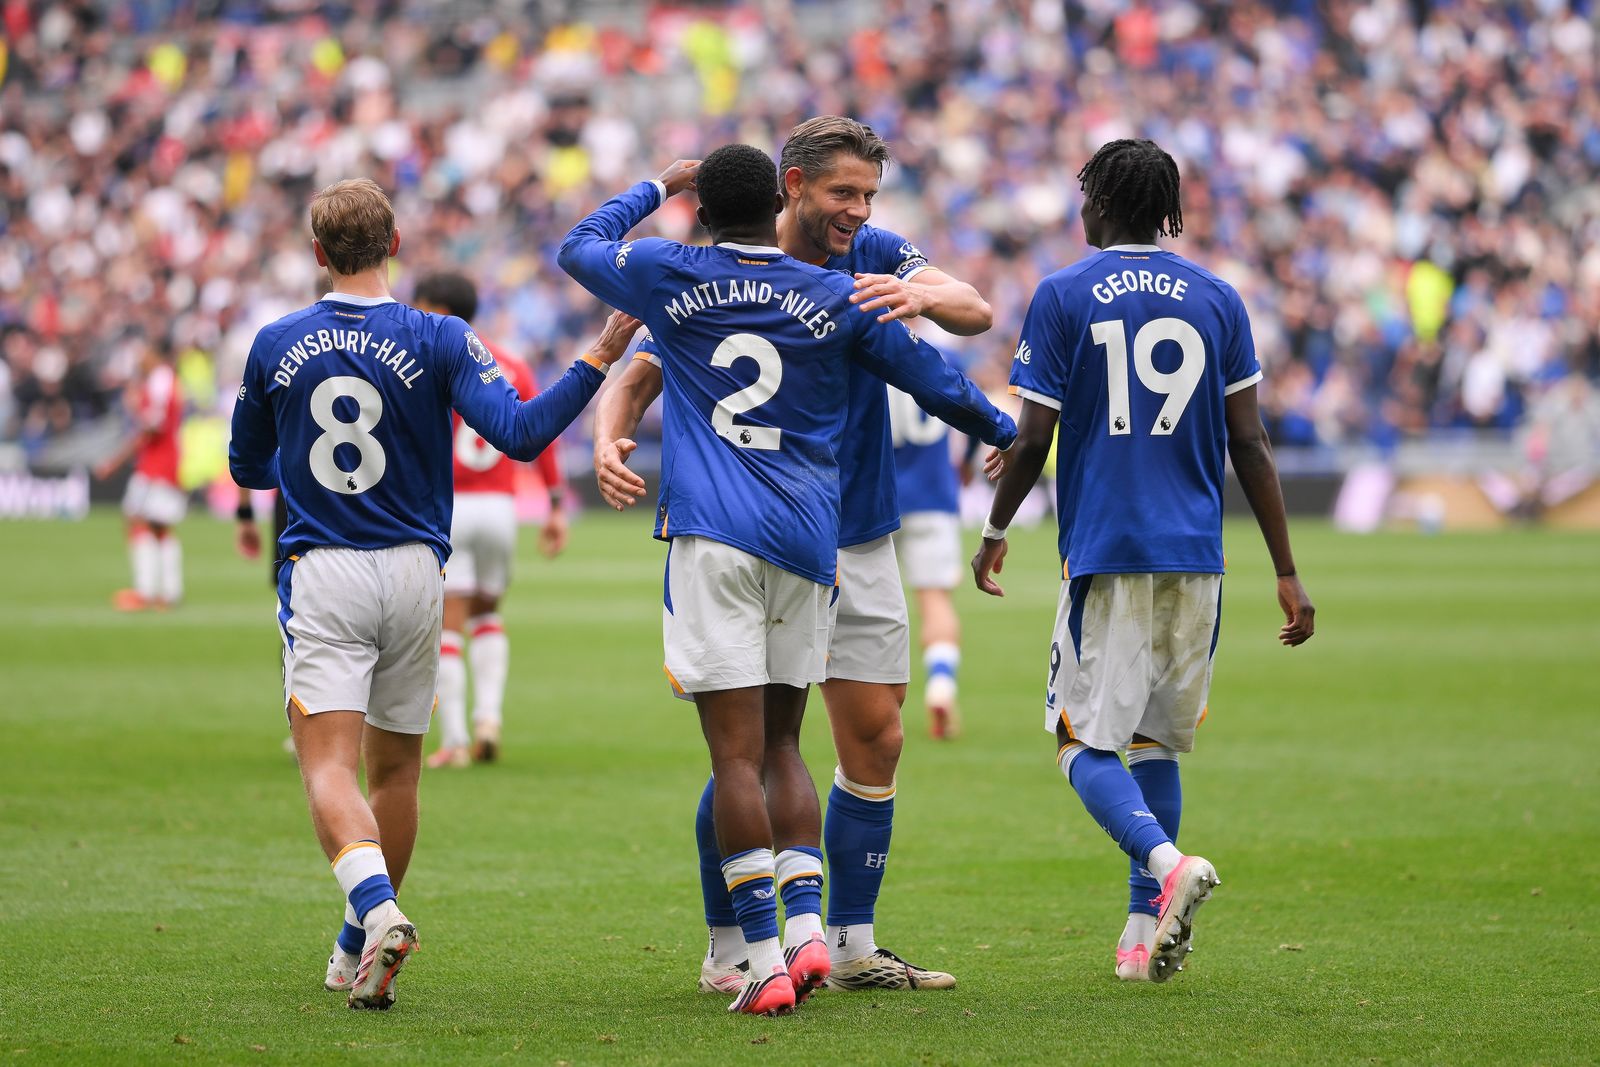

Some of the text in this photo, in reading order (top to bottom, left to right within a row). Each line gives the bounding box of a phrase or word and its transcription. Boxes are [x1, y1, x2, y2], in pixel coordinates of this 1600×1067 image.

[664, 279, 836, 340] MAITLAND-NILES
[1092, 270, 1188, 303] GEORGE
[274, 328, 424, 390] DEWSBURY-HALL
[1090, 317, 1206, 436] 19
[710, 333, 783, 451] 2
[309, 375, 386, 495] 8
[864, 852, 888, 869] EF
